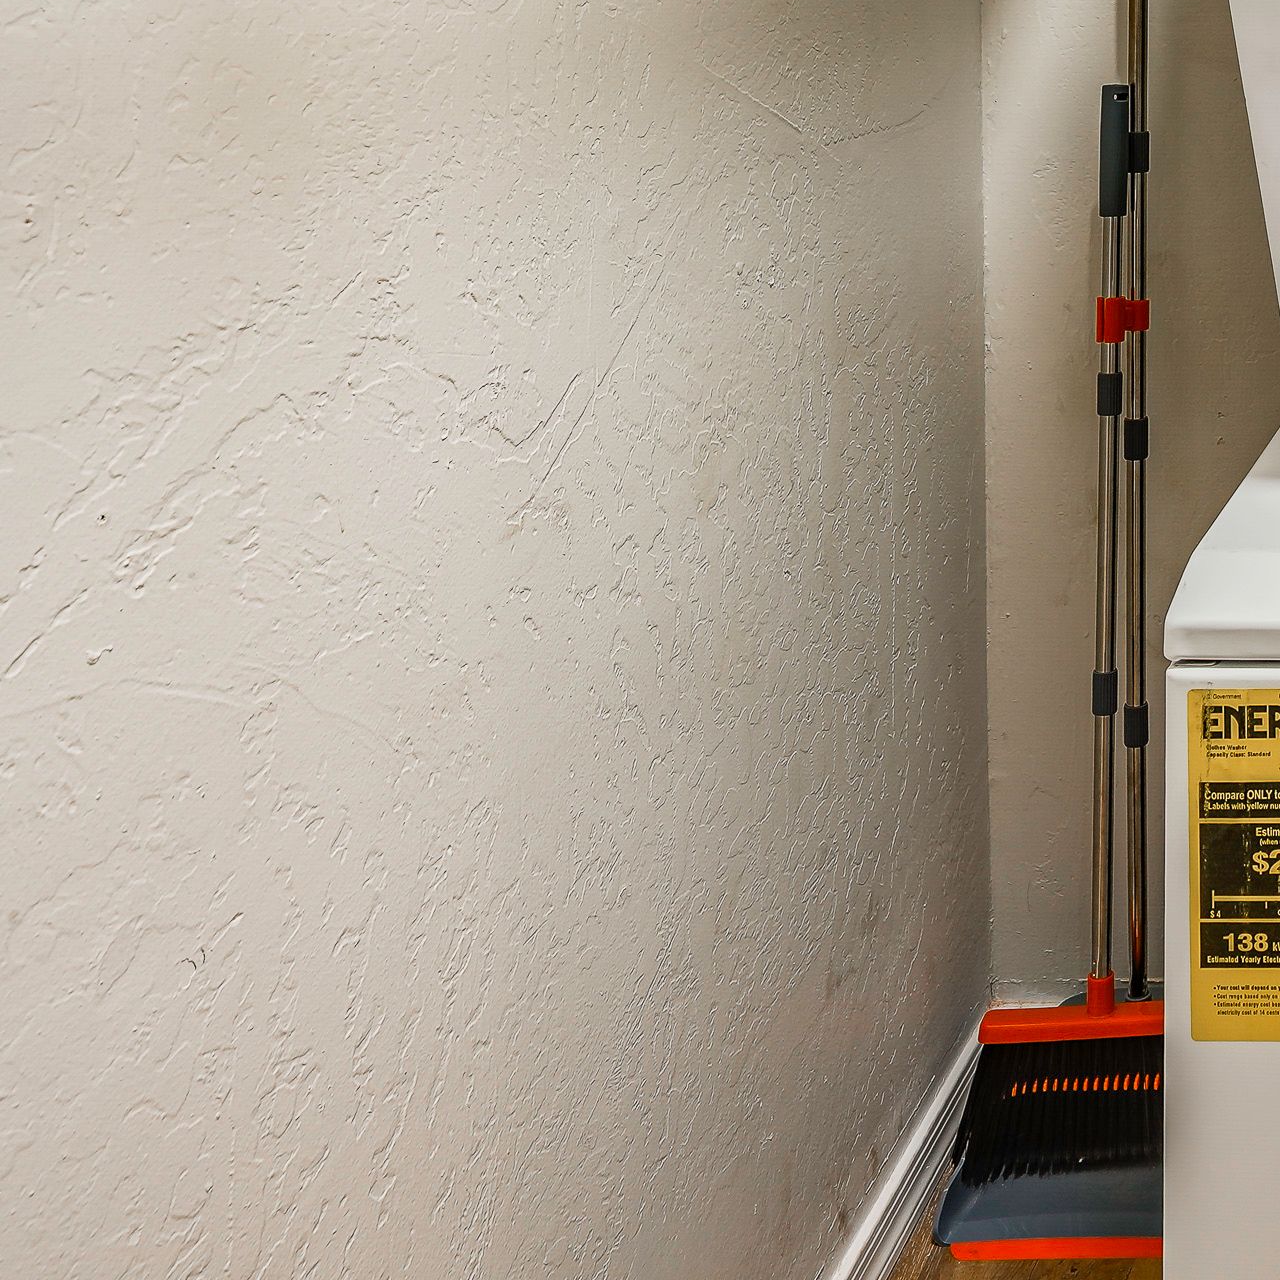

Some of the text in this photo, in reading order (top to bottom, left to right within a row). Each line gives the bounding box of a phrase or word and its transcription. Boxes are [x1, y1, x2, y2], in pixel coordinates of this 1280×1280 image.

[1205, 791, 1245, 801] Compare
[1247, 790, 1272, 800] ONLY
[1223, 933, 1268, 951] 138
[1207, 956, 1239, 964] Estimated
[1241, 956, 1261, 964] Yearly
